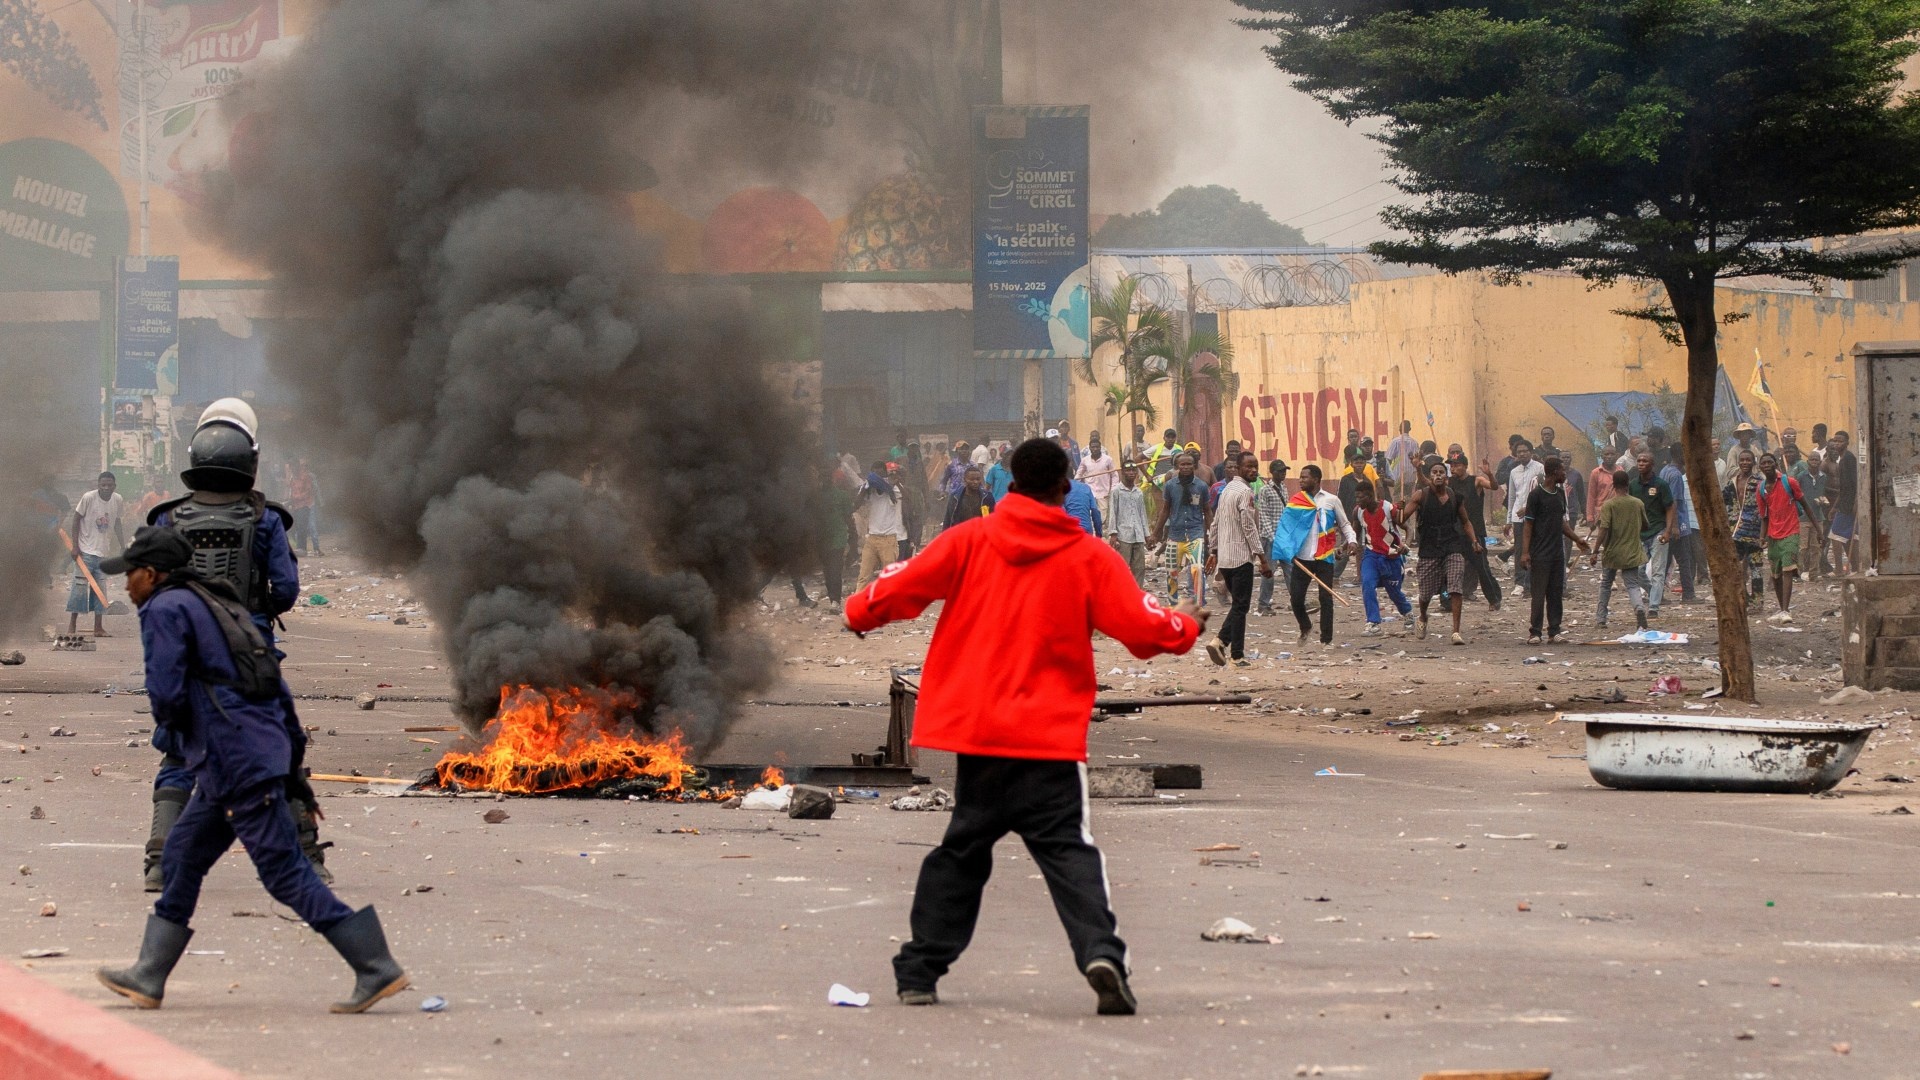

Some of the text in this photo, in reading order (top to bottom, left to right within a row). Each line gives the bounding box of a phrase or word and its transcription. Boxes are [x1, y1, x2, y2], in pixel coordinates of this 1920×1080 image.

[181, 20, 259, 68] nutry
[204, 67, 243, 84] 100%
[1016, 170, 1076, 183] SOMMET
[12, 175, 89, 218] NOUVEL
[1029, 195, 1076, 208] CIRGL
[1028, 219, 1060, 236] paix
[997, 232, 1076, 248] la sécurité
[988, 282, 1047, 291] 15 Nov. 2025
[141, 290, 172, 298] SOMMET
[146, 303, 172, 312] CIRGL
[146, 317, 163, 325] paix
[137, 325, 172, 334] sécurité
[1239, 375, 1389, 462] SÉVIGNÉ
